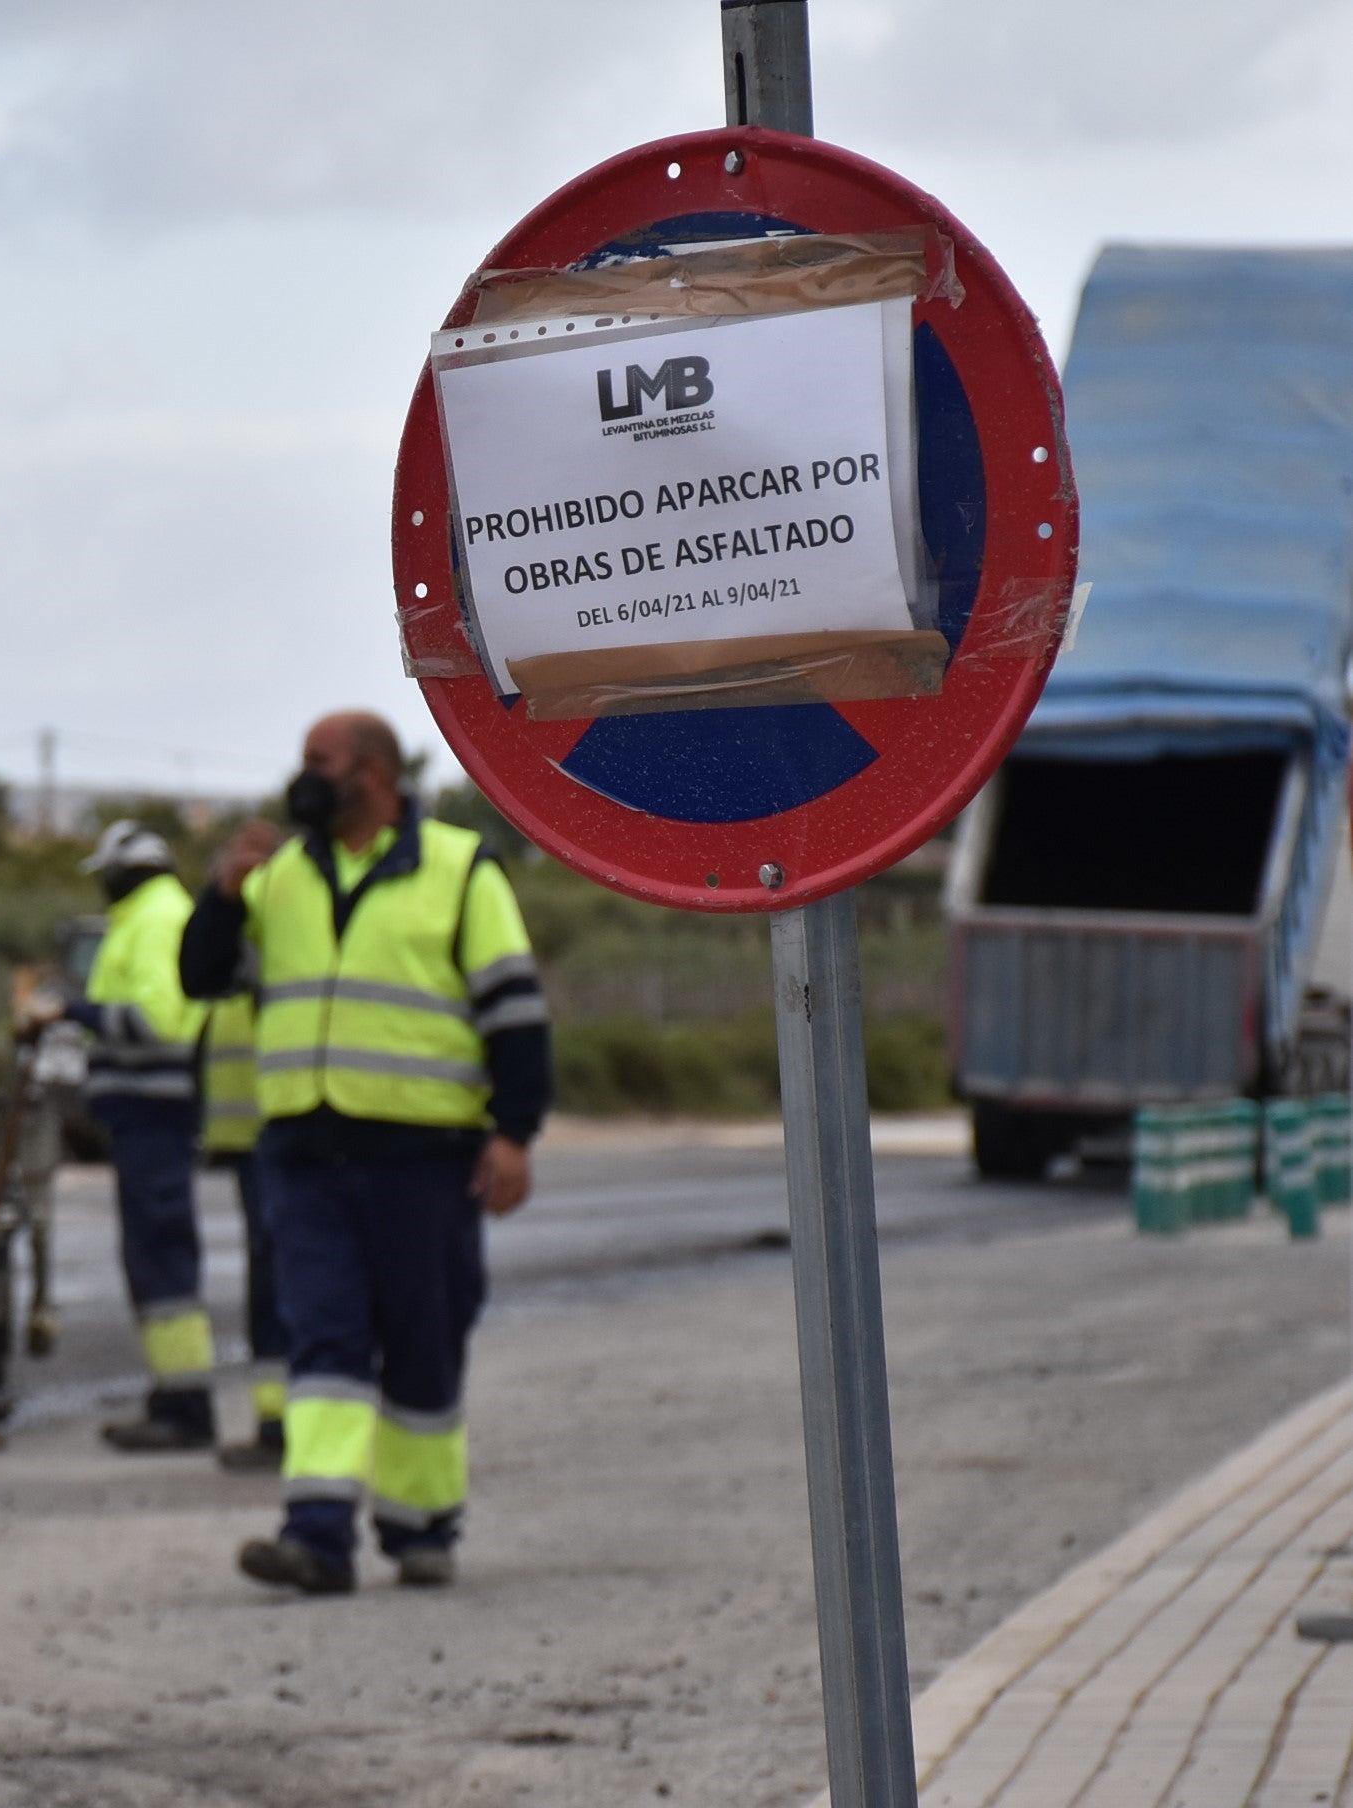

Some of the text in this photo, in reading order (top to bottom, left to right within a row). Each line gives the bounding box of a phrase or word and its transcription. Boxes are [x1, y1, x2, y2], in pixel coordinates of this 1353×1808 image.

[597, 356, 714, 422] LMB
[602, 410, 715, 436] LEVANTINA DE MEZCLAS
[633, 424, 698, 442] BITUMINOSAS
[465, 453, 880, 545] PROHIBIDO APARCAR POR
[504, 514, 855, 594] OBRAS DE ASFALTADO
[577, 577, 801, 628] DEL 6/04/21 AL 9/04/21
